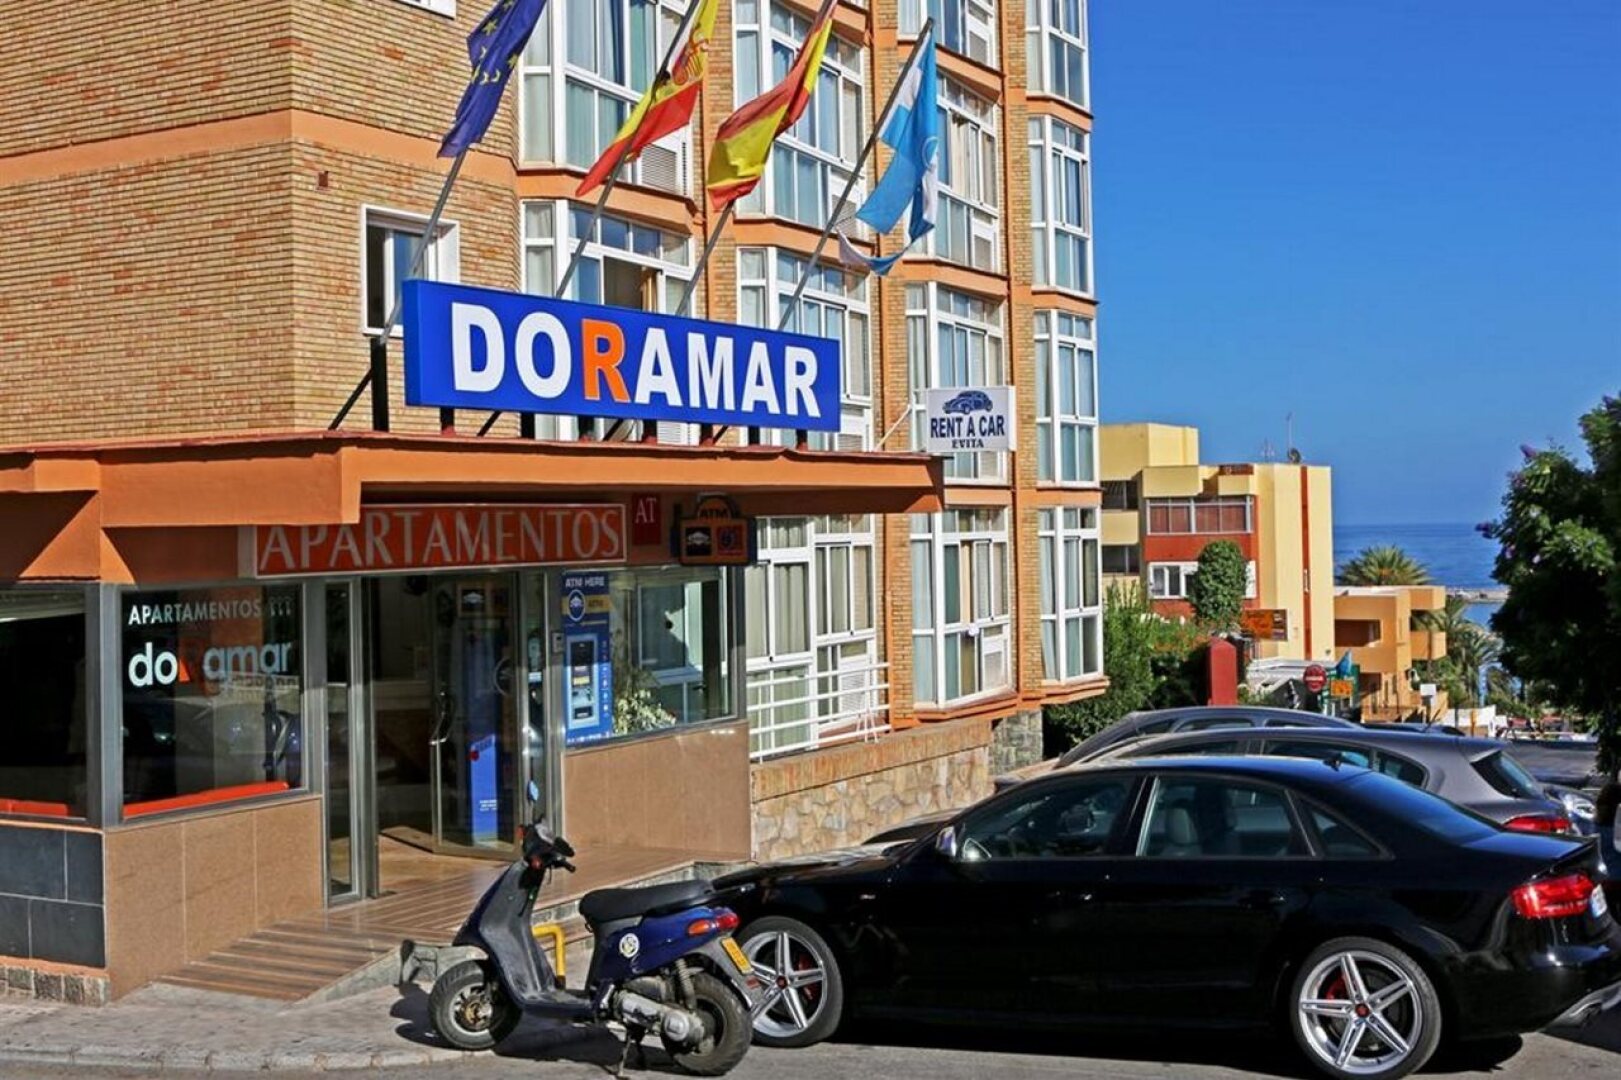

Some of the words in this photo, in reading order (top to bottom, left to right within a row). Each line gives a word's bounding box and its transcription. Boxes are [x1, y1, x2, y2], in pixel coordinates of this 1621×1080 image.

[452, 302, 821, 418] DORAMAR
[930, 417, 963, 438] RENT
[967, 416, 976, 437] A
[979, 415, 1005, 437] CAR
[952, 439, 984, 449] EVITA
[635, 497, 657, 523] AT
[259, 509, 620, 571] APARTAMENTOS
[128, 599, 262, 625] APARTAMENTOS
